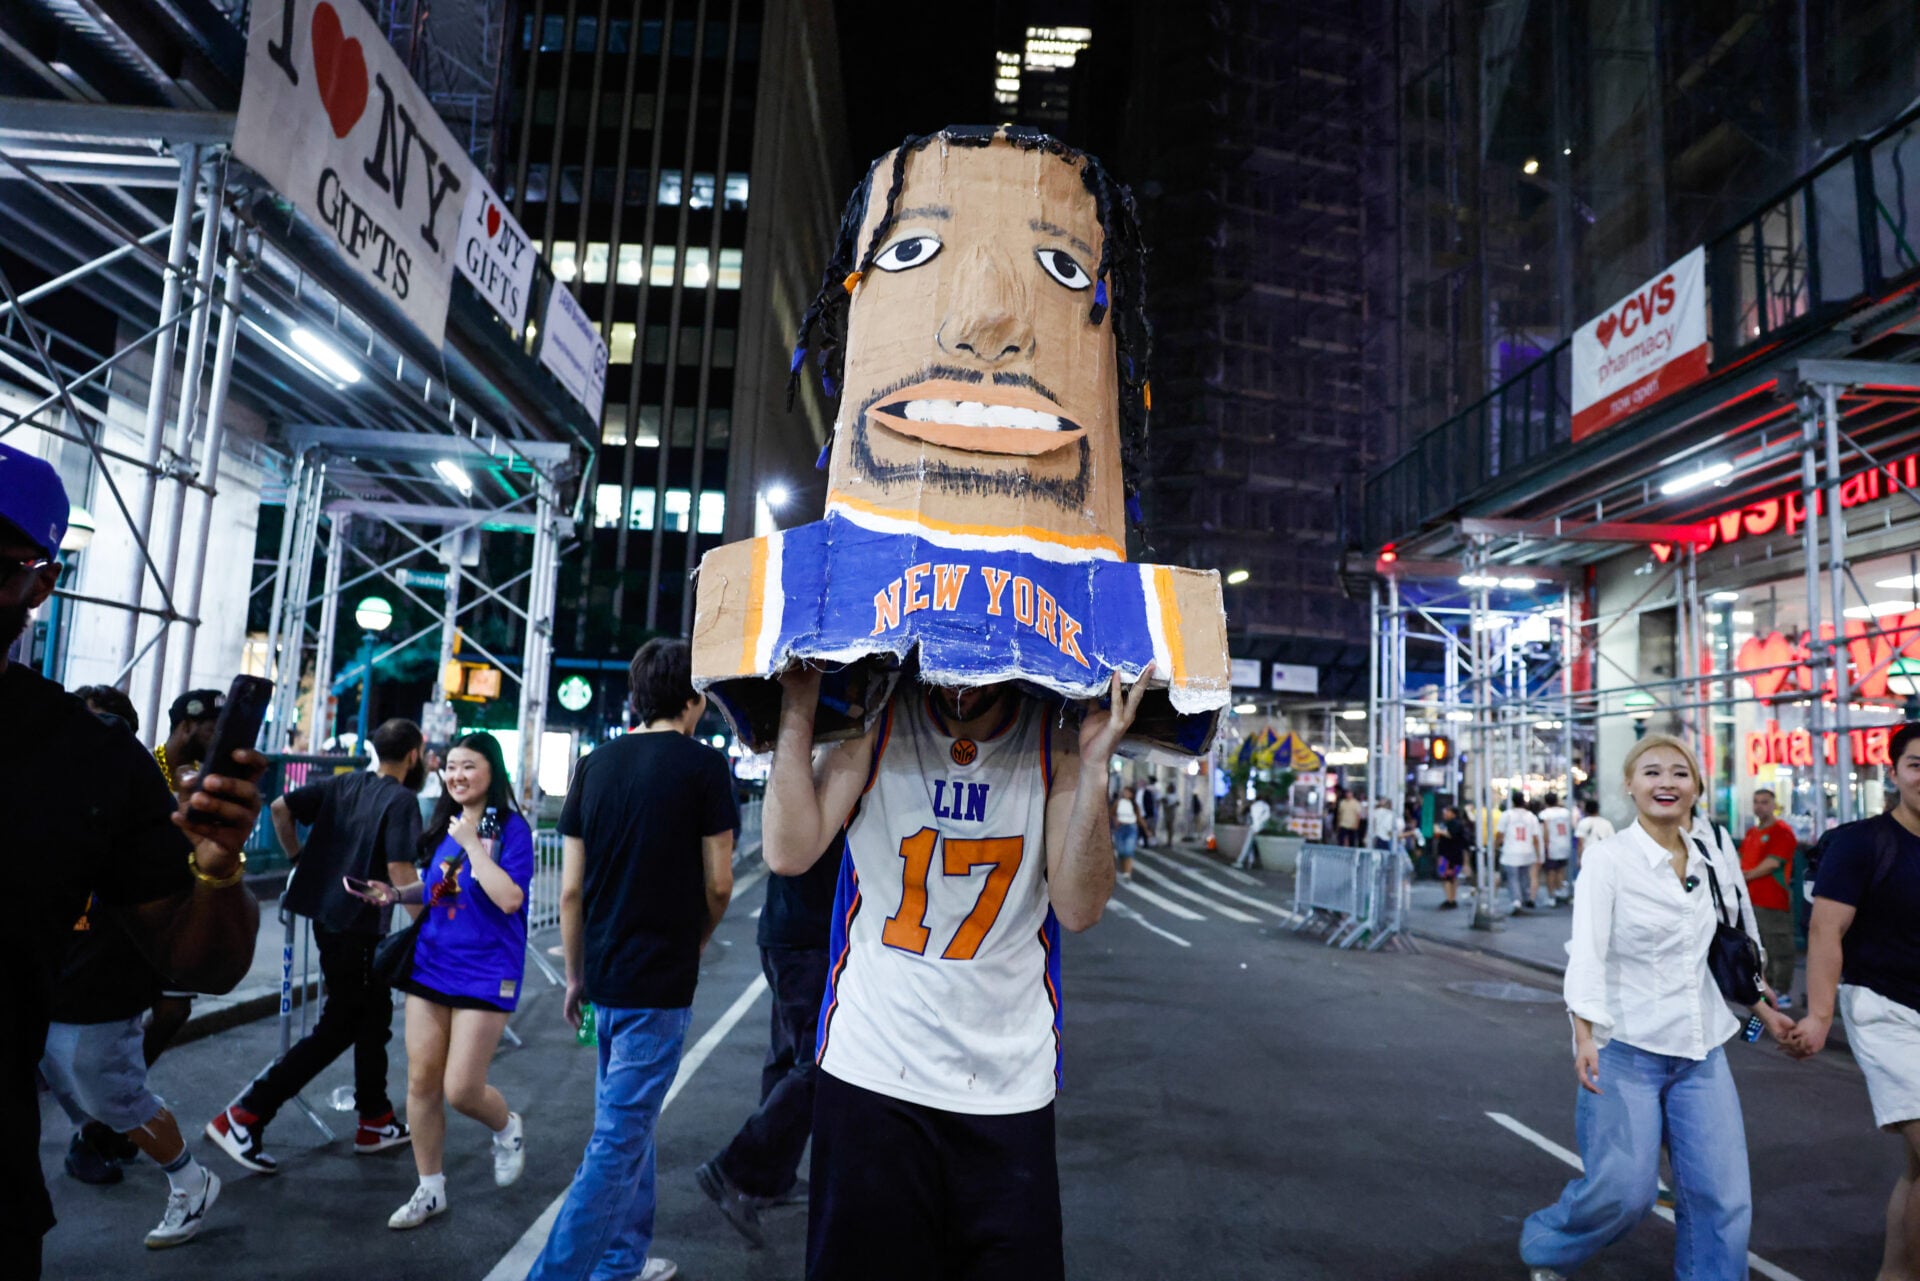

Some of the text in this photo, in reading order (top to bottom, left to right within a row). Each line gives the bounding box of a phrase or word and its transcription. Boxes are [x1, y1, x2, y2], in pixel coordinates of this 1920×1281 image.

[268, 0, 461, 253] I NY
[317, 167, 411, 300] GIFTS
[476, 190, 525, 270] I NY
[466, 236, 519, 318] GIFTS
[1619, 273, 1676, 338] CVS
[1599, 323, 1675, 385] pharmacy
[869, 562, 1091, 669] NEW YORK
[933, 779, 990, 822] LIN
[882, 826, 1024, 960] 17
[281, 947, 293, 1013] NYPD
